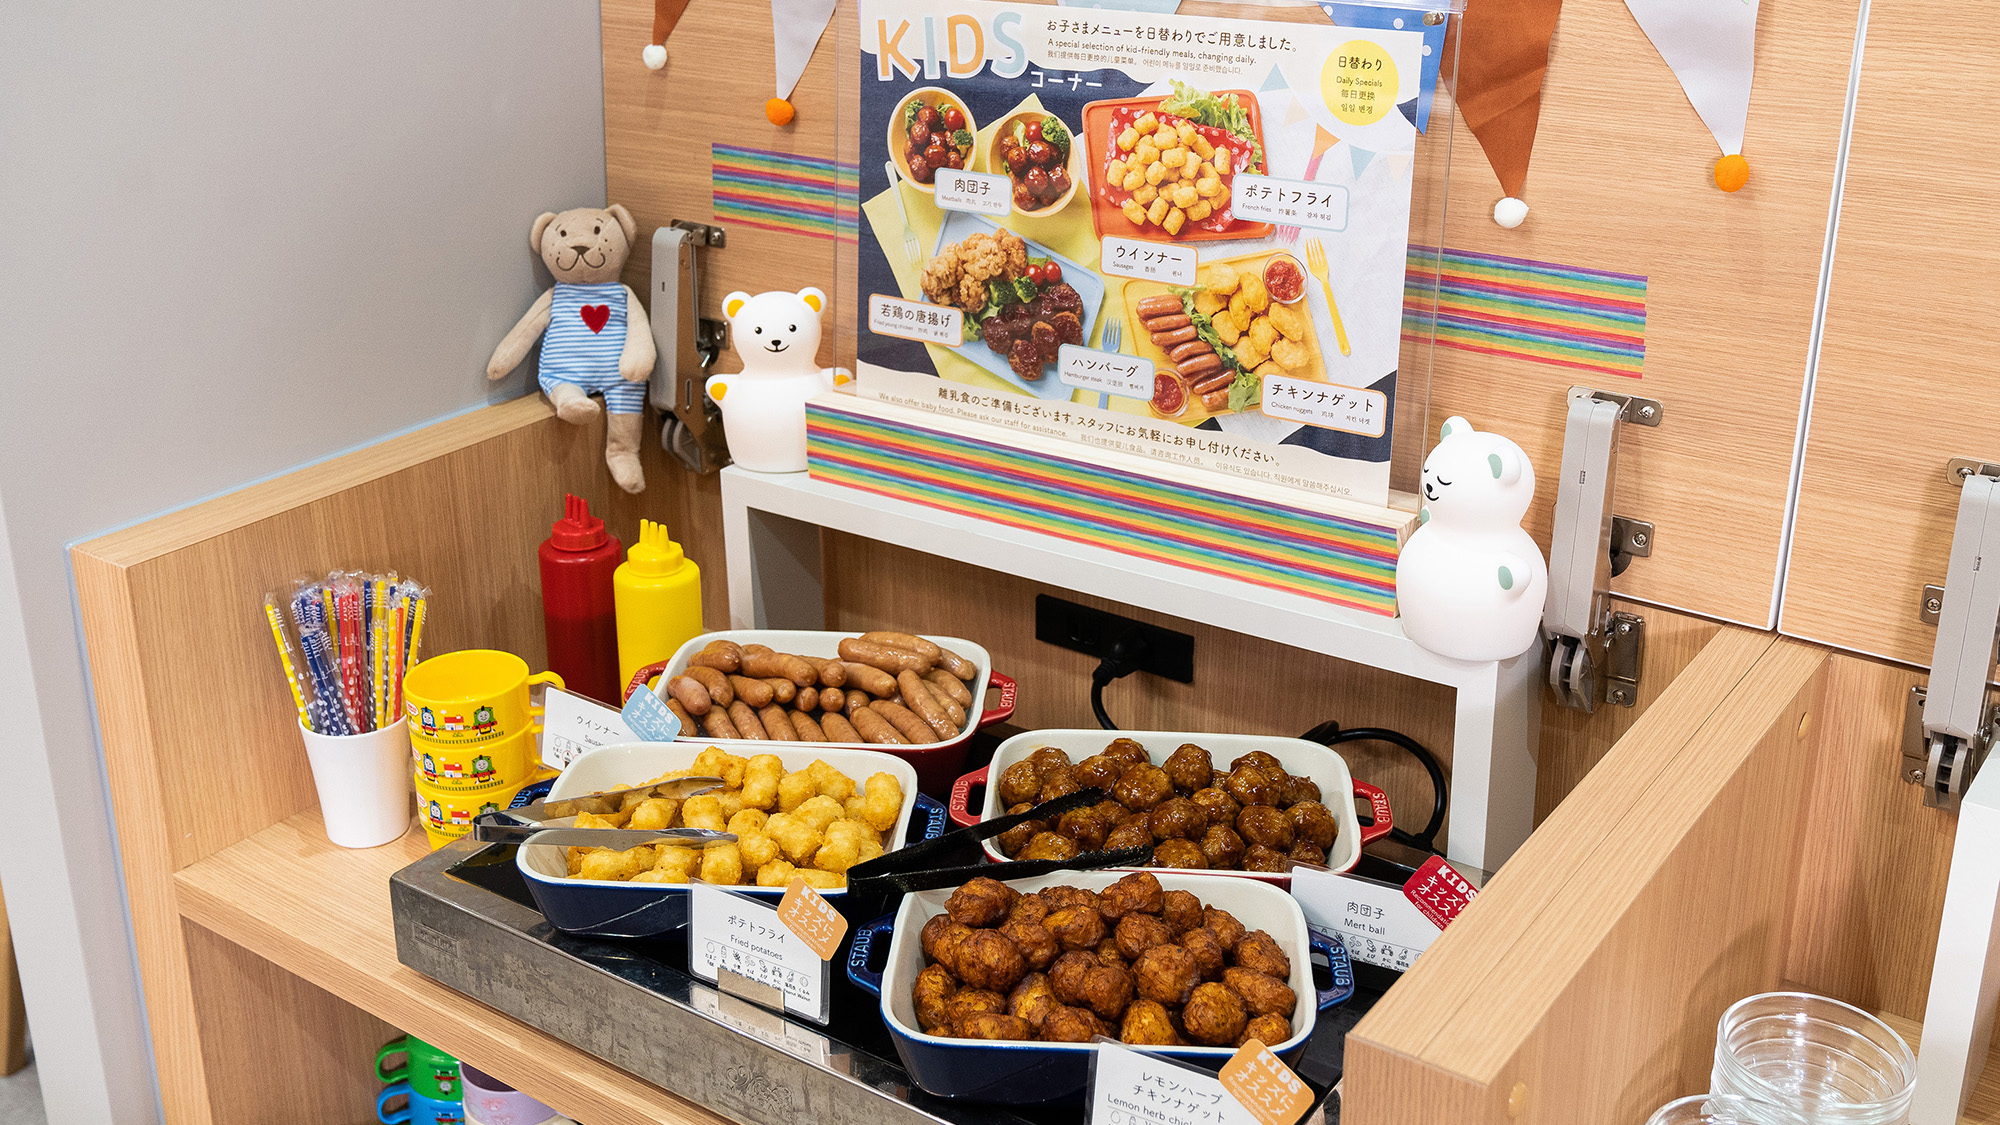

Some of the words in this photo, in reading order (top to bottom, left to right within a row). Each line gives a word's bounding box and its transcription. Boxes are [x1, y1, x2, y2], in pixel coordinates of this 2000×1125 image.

[877, 11, 1026, 77] KIDS
[1047, 19, 1297, 52] お子さまメニューを日替わりでご用意しました。
[1048, 38, 1054, 46] A
[1055, 40, 1080, 52] special
[1082, 42, 1114, 50] selection
[1116, 44, 1124, 52] of
[1126, 45, 1170, 58] kid-friendly
[1172, 50, 1196, 60] meals,
[1198, 51, 1233, 65] changing
[1235, 53, 1257, 65] daily.
[1338, 56, 1383, 71] 日替わり
[1030, 71, 1103, 92] コーナー
[1336, 75, 1354, 87] Daily
[1355, 77, 1383, 88] Specials
[954, 178, 991, 196] 肉団子
[1245, 184, 1332, 208] ポテトフライ
[1242, 202, 1260, 211] French
[1260, 205, 1272, 213] fries
[1116, 245, 1182, 264] ウインナー
[881, 303, 952, 328] 若鶏の唐揚げ
[1064, 371, 1090, 381] Hamburger
[1072, 359, 1139, 378] ハンバーグ
[1271, 401, 1293, 411] Chicken
[1293, 406, 1313, 415] nuggets
[1272, 383, 1373, 412] チキンナゲット
[879, 392, 889, 400] We
[891, 395, 903, 404] also
[904, 398, 920, 407] offer
[921, 402, 937, 412] baby
[939, 405, 955, 415] food.
[956, 407, 977, 419] Please
[979, 413, 989, 421] ask
[991, 416, 1002, 424] our
[1004, 418, 1019, 428] staff
[1020, 421, 1031, 430] for
[1032, 425, 1068, 438] assistance.
[938, 387, 1280, 467] 離乳食のご準備もございます。スタッフにお気軽にお申し付けください。
[644, 691, 674, 725] KIDS
[1001, 682, 1016, 708] STAUB
[576, 715, 620, 736] ウインナー
[637, 701, 670, 736] キッズに
[952, 780, 969, 811] STAUB
[1372, 792, 1391, 823] STAUB
[925, 807, 944, 840] STAUB
[1437, 865, 1478, 903] KIDS
[794, 897, 834, 937] キッズに
[801, 886, 837, 923] KIDS
[1346, 901, 1385, 920] 肉団子
[1414, 901, 1424, 910] for
[1422, 909, 1444, 930] children
[727, 914, 786, 943] ポテトフライ
[788, 906, 830, 944] オススメ
[1344, 917, 1366, 931] Mert
[1368, 922, 1386, 936] ball
[730, 934, 750, 950] Fried
[750, 943, 784, 961] potatoes
[851, 929, 873, 967] STAUB
[1330, 946, 1351, 986] STAUB
[1245, 1060, 1295, 1111] キッズに
[1256, 1049, 1302, 1095] KIDS
[1142, 1071, 1223, 1105] レモンハーブ
[1235, 1070, 1285, 1117] オススメ
[1107, 1092, 1140, 1112] Lemon
[1143, 1105, 1166, 1121] herb
[1133, 1084, 1225, 1123] チキンナゲット
